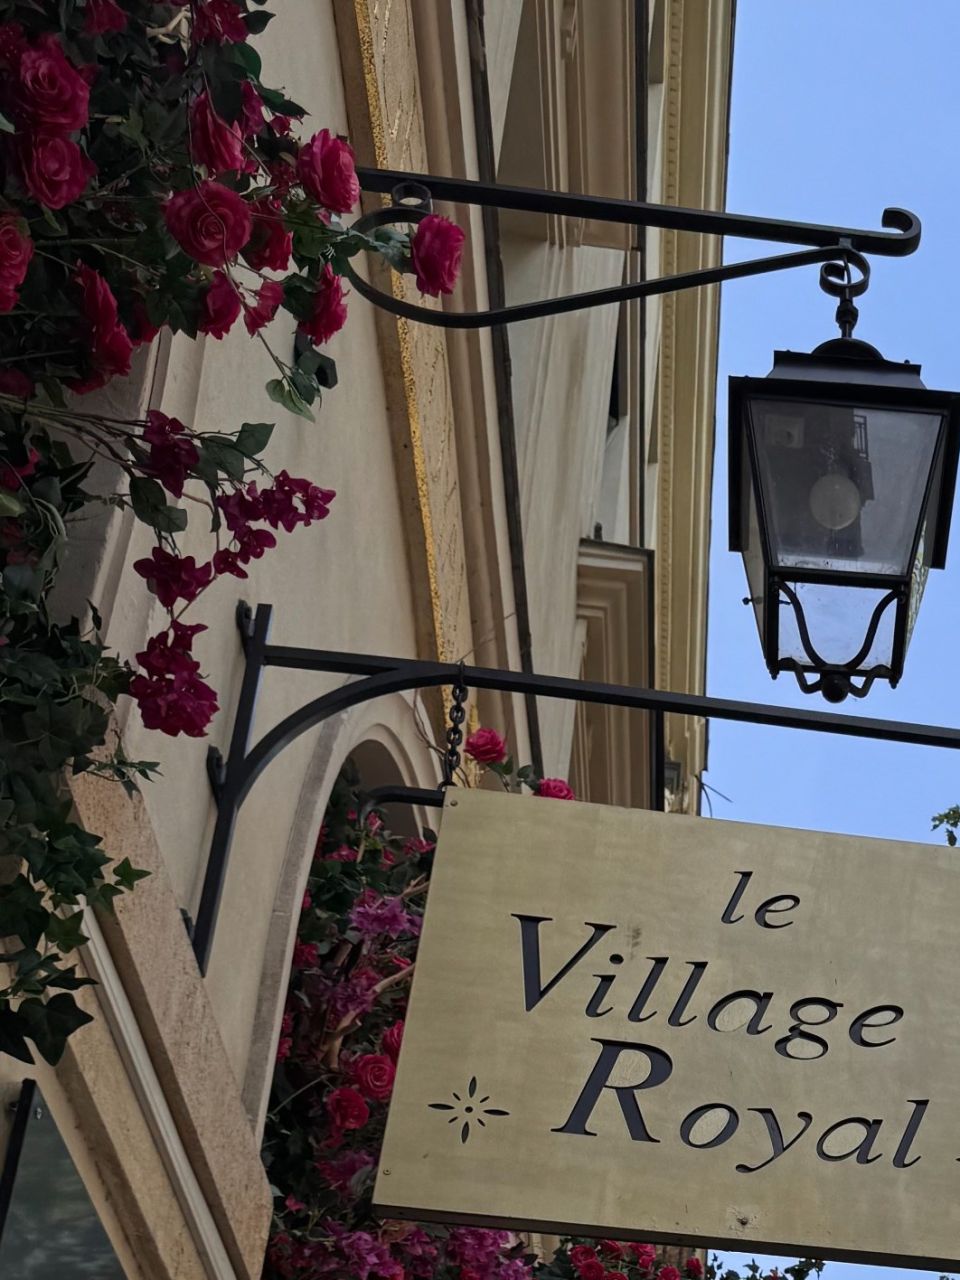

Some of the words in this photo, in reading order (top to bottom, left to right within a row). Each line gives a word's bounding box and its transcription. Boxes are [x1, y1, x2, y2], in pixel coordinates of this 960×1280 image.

[721, 870, 801, 929] le
[510, 912, 904, 1060] Village
[550, 1037, 930, 1173] Royal
